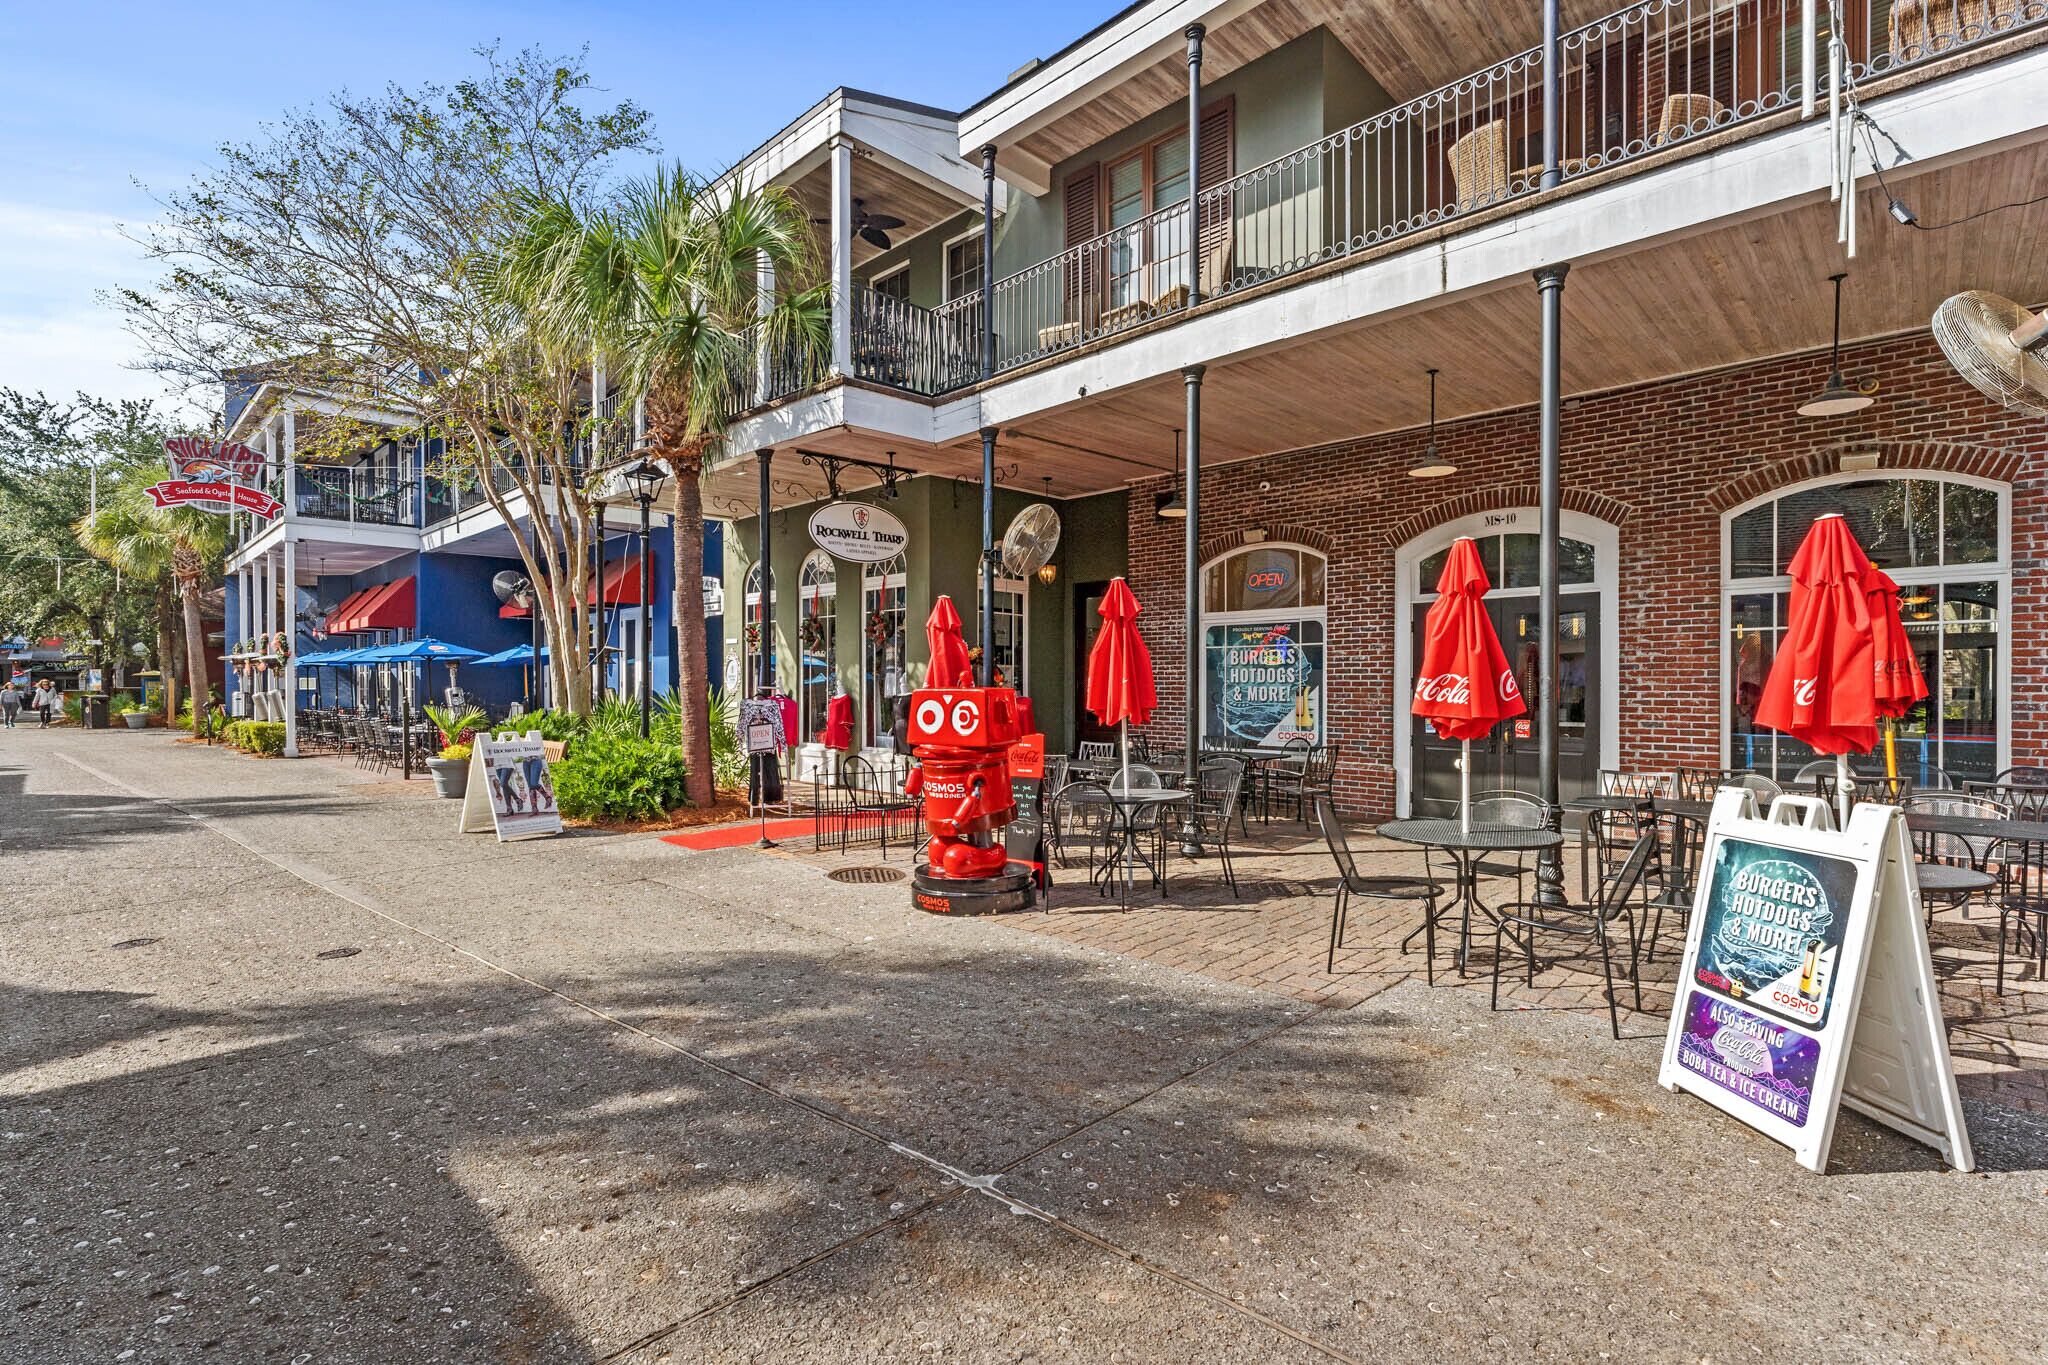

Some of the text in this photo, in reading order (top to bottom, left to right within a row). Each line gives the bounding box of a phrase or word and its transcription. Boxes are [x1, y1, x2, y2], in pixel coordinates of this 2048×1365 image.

[175, 487, 204, 495] Seafood
[212, 488, 232, 498] Oyste
[237, 492, 258, 503] House
[1485, 513, 1517, 527] MS-10
[1248, 572, 1285, 588] OPEN
[1230, 668, 1295, 683] HOTDOGS
[1233, 685, 1291, 702] & MORE!
[751, 730, 770, 738] OPEN
[917, 894, 950, 907] COSMOS
[1738, 872, 1818, 907] BURGER'S
[1732, 893, 1812, 932] HOTDOGS
[1731, 917, 1804, 955] & MORE!
[1773, 991, 1818, 1014] COSMO
[1710, 1005, 1784, 1048] ALSO SERVING
[1716, 1030, 1767, 1065] Coca-Cola
[1722, 1056, 1754, 1078] PRODUCTS
[1683, 1050, 1799, 1120] BOBA TEA & ICE CREAM
